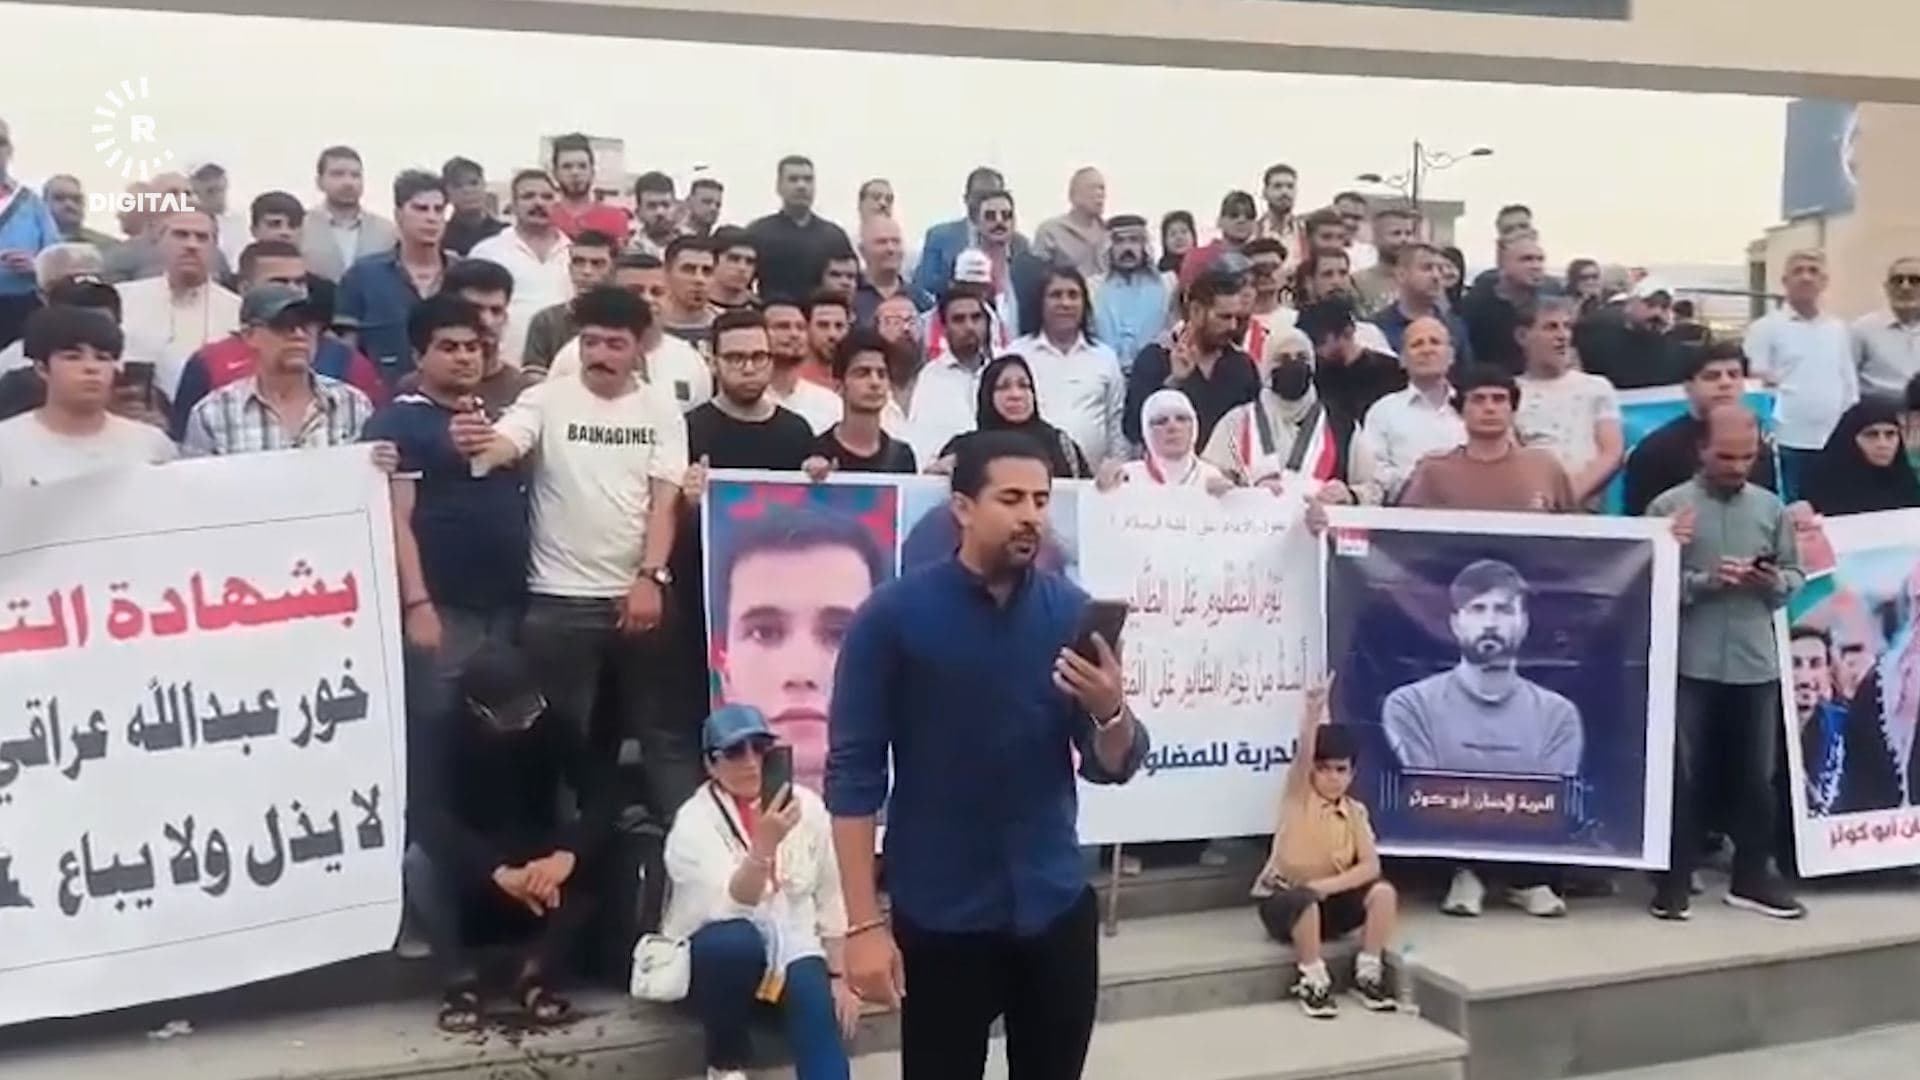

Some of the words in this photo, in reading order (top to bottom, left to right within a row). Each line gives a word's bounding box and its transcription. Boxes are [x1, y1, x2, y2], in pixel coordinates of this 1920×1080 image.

[107, 559, 360, 641] بشهادة
[291, 657, 369, 749] خور
[1143, 742, 1228, 777] للمضلو
[1235, 737, 1298, 772] لحرية
[57, 831, 156, 918] يباع
[246, 800, 344, 888] يذل
[1829, 821, 1869, 850] كوثر
